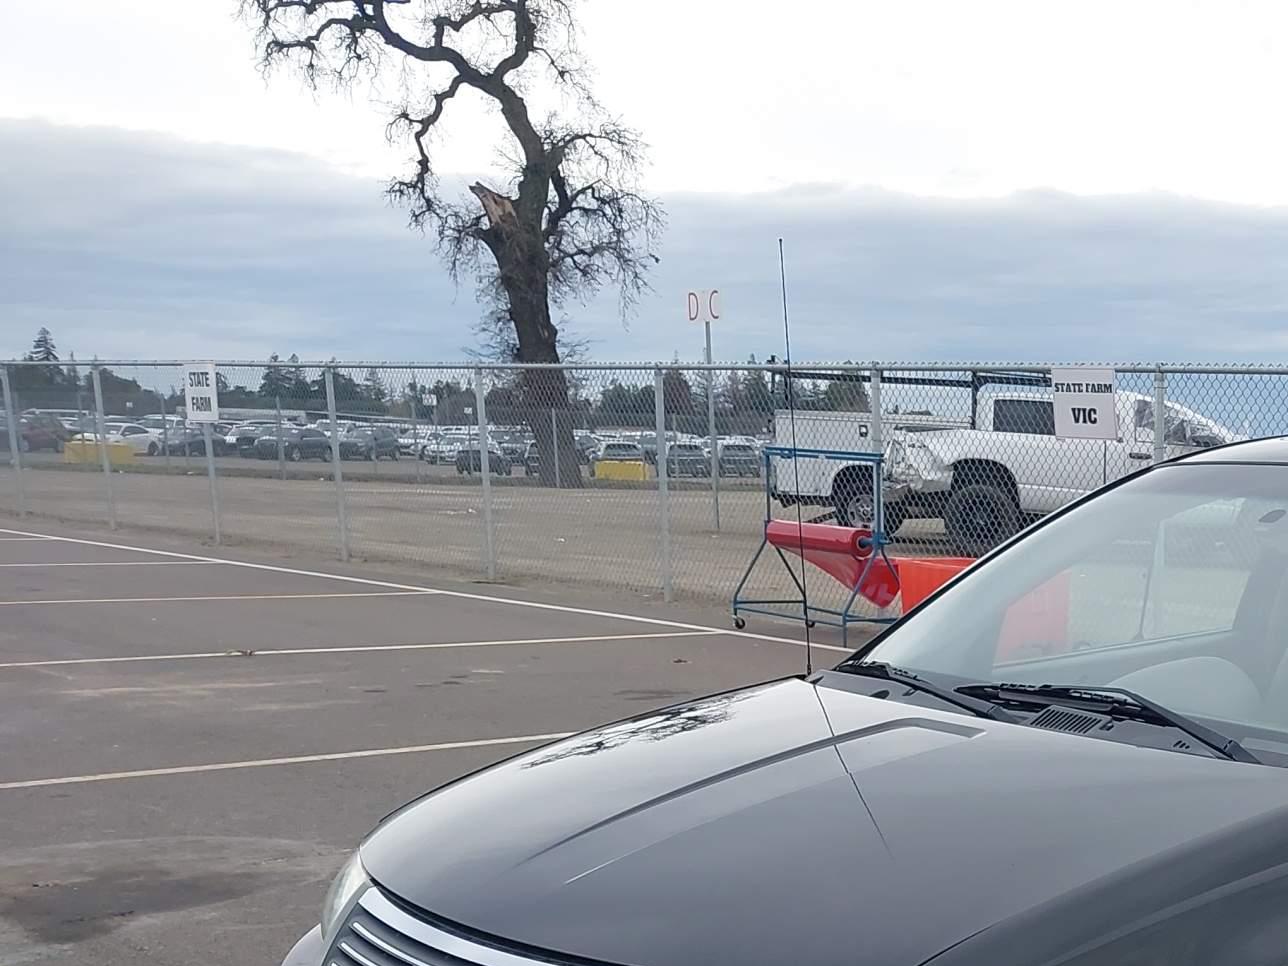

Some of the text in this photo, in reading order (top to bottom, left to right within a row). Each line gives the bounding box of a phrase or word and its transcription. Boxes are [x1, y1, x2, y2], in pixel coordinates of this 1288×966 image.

[688, 292, 699, 321] D
[189, 371, 210, 387] STATE
[1054, 383, 1113, 394] STATE FARM
[192, 396, 212, 412] FARM
[1071, 407, 1098, 425] VIC
